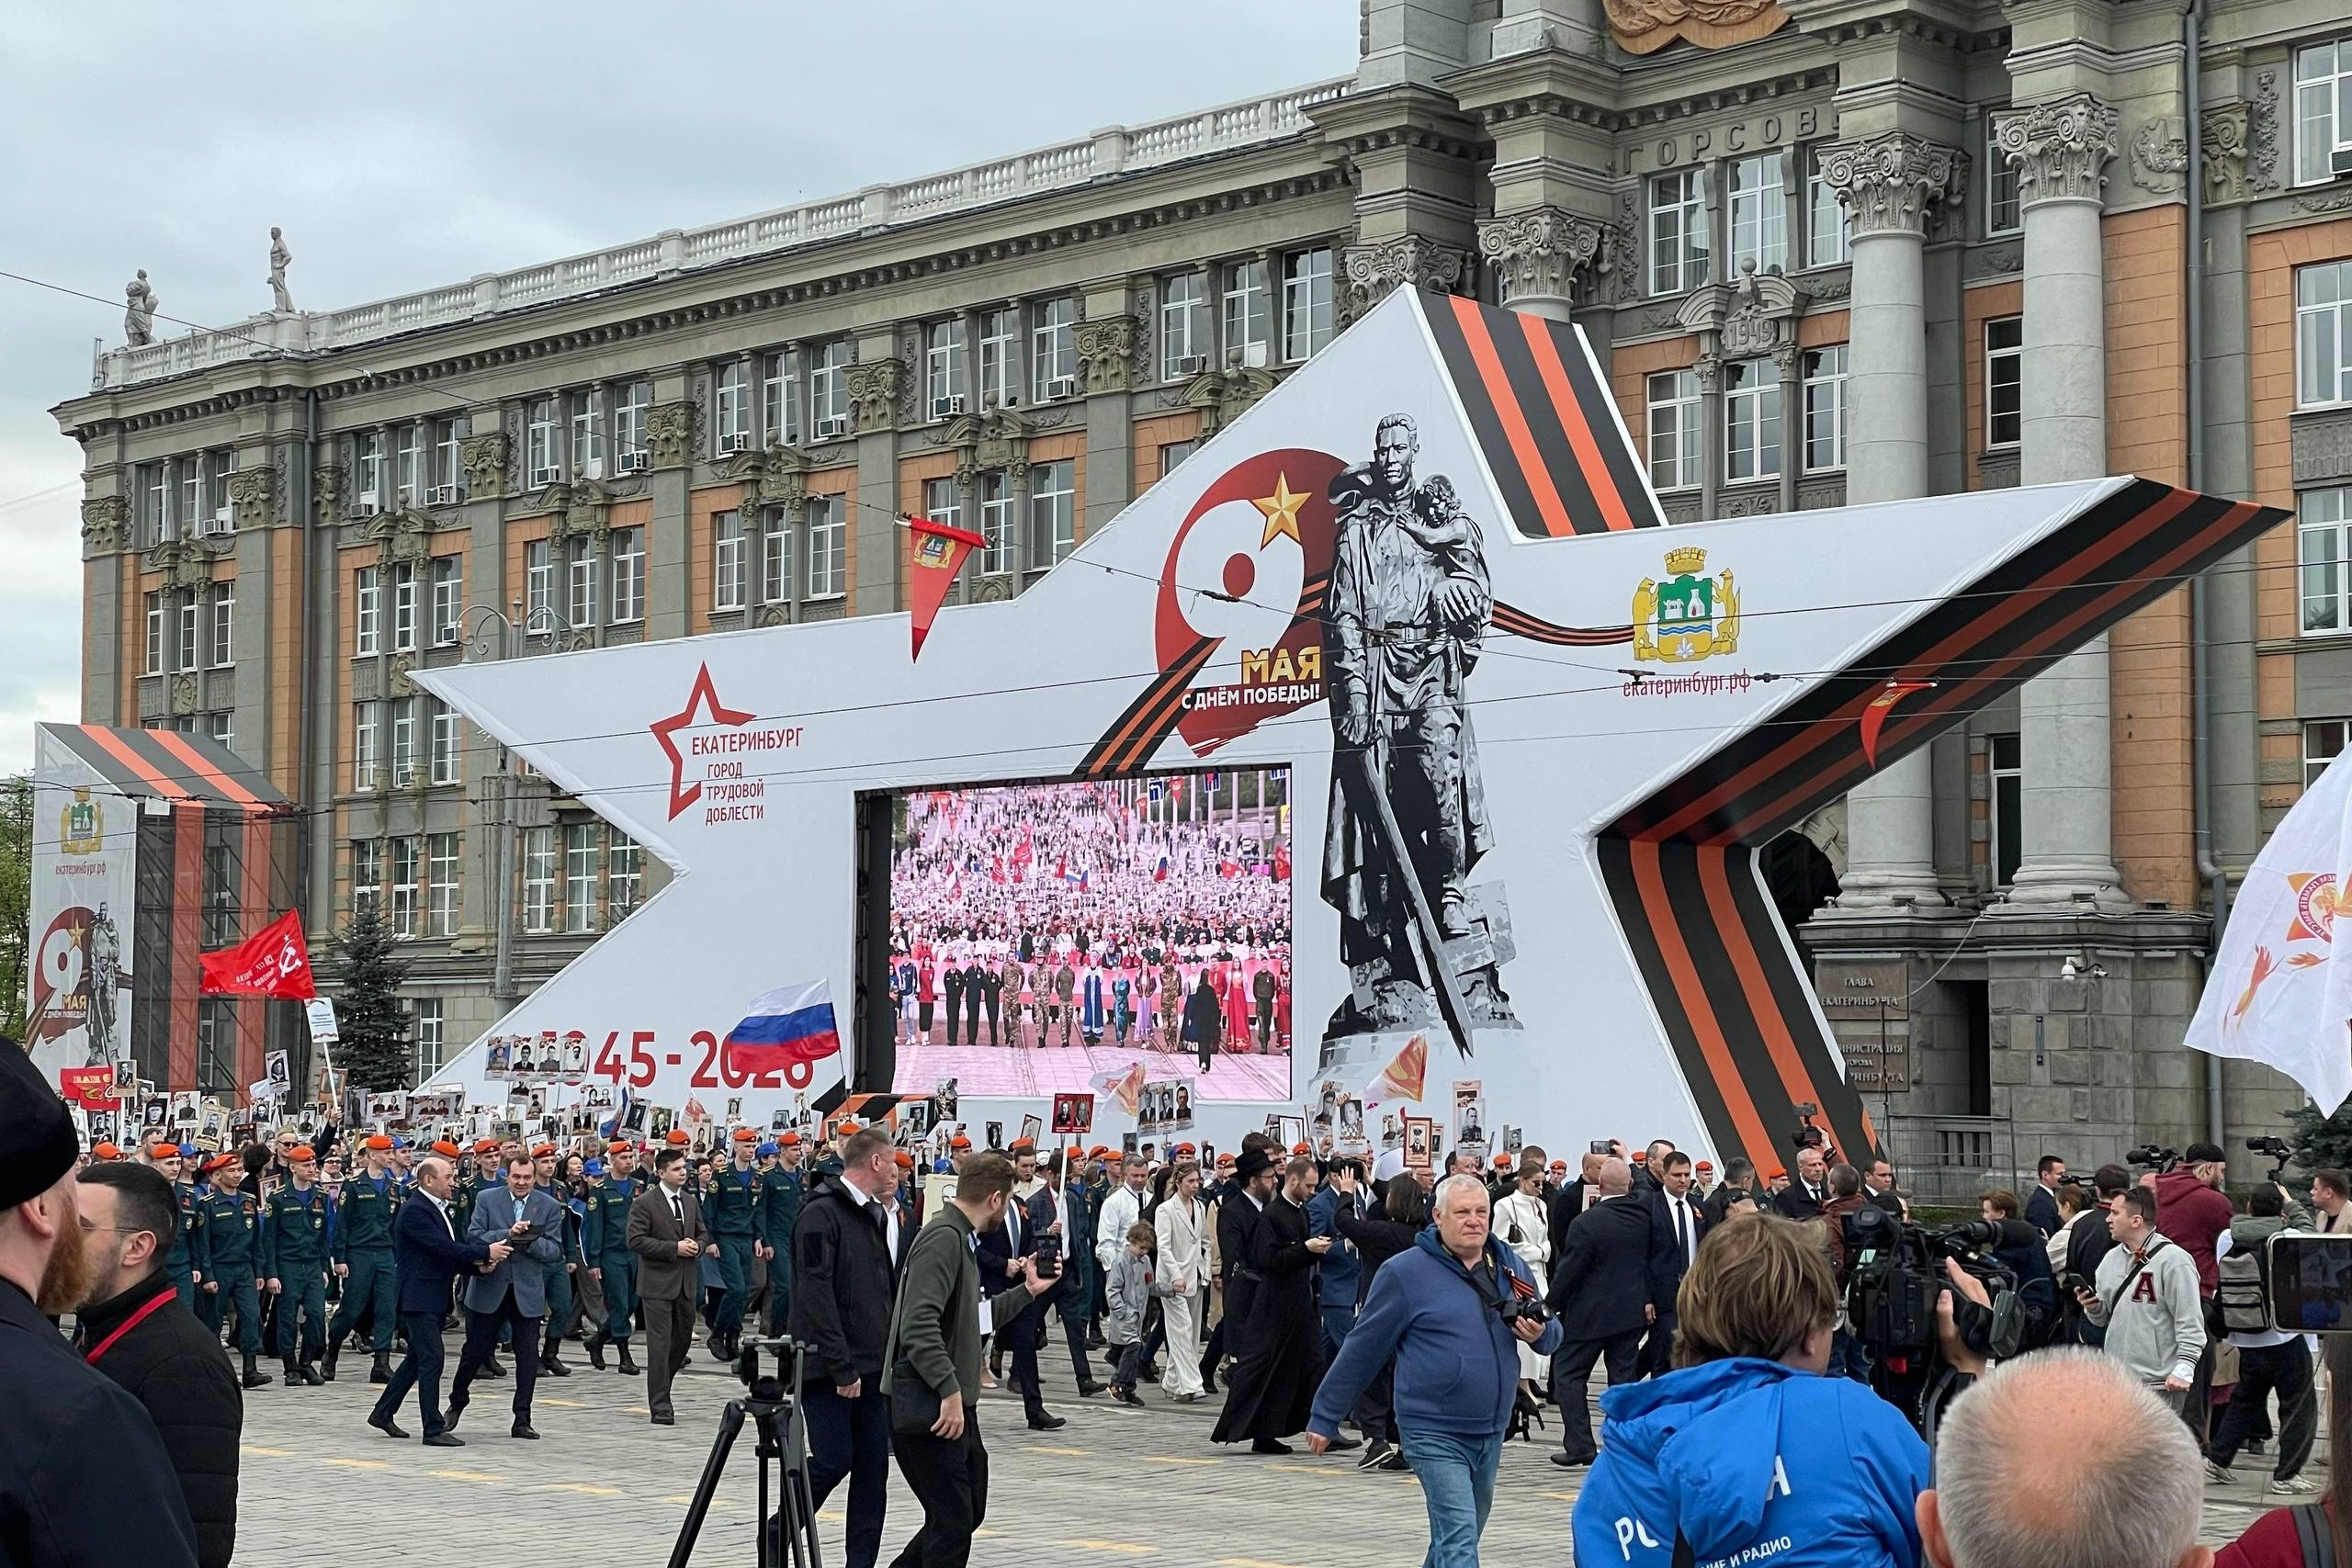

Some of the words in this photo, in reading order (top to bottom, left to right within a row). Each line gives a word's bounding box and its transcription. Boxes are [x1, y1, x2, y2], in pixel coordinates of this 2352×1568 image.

[1623, 106, 1838, 175] ГОРСОВ
[1241, 645, 1320, 684] МАЯ
[1181, 694, 1192, 709] С
[1193, 687, 1239, 711] ДНЁМ
[1243, 683, 1320, 705] ПОБЕДЫ!
[1623, 668, 1751, 698] екатеринбург.рф
[692, 727, 804, 755] ЕКАТЕРИНБУРГ
[707, 761, 742, 779] ГОРОД
[707, 778, 764, 803] ТРУДОВОЙ
[706, 804, 764, 827] ДОБЛЕСТИ
[1844, 977, 1874, 987] ГЛАВА
[62, 994, 87, 1010] МАЯ
[541, 1030, 814, 1089] 45-20
[2132, 1271, 2157, 1304] A
[1729, 1553, 1740, 1568] И
[1742, 1536, 1792, 1562] РАДИО
